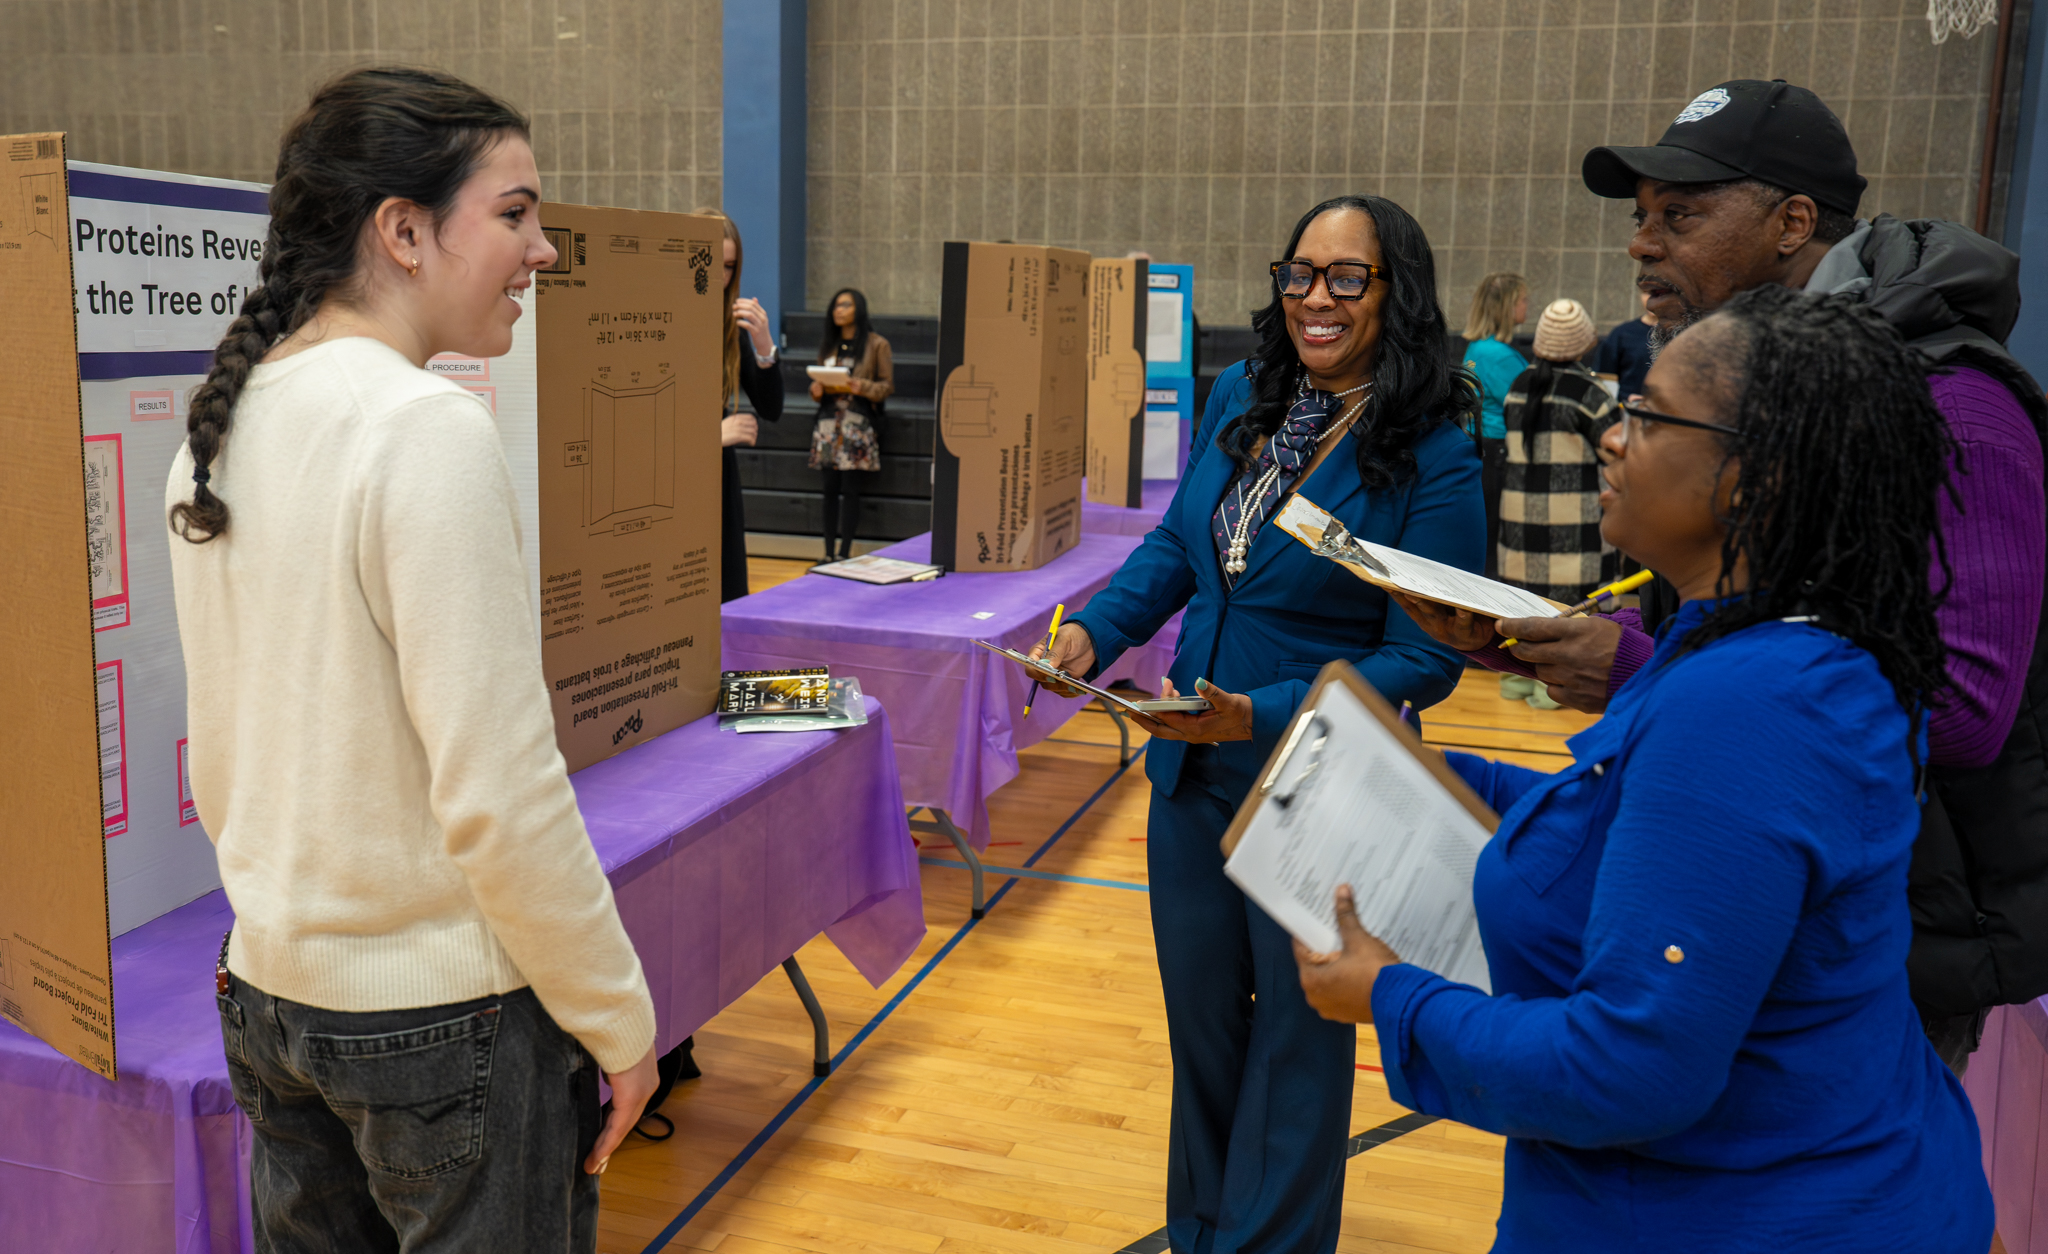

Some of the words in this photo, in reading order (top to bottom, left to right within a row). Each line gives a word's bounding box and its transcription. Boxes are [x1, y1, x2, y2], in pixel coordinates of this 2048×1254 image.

[75, 218, 194, 259] Proteins
[202, 229, 266, 262] Reve
[86, 280, 134, 315] the
[141, 284, 202, 315] Tree
[210, 284, 237, 315] of
[138, 401, 167, 411] RESULTS
[1022, 413, 1032, 449] battants
[999, 448, 1009, 475] Board
[1010, 444, 1020, 509] presentaciones
[997, 476, 1007, 531] Presentation
[1010, 511, 1018, 531] para
[663, 635, 693, 654] Panneau
[614, 661, 619, 673] à
[621, 646, 662, 669] d'affichage
[555, 670, 590, 691] battants
[593, 663, 612, 679] trois
[635, 665, 652, 681] para
[572, 671, 633, 705] presentaciones
[651, 676, 678, 698] Tri-Fold
[728, 682, 740, 712] MARY
[744, 682, 757, 712] HAIL
[800, 679, 810, 709] WEIR
[816, 678, 829, 708] ANDY
[600, 687, 650, 713] Presentation
[573, 706, 599, 728] Board
[612, 709, 644, 747] Pacon
[30, 959, 44, 974] triples
[45, 967, 53, 978] plis
[33, 976, 54, 997] Board
[76, 984, 83, 995] de
[84, 987, 107, 1006] panneau
[54, 988, 79, 1011] Project
[80, 1002, 97, 1021] Fold
[98, 1011, 108, 1027] Tri
[71, 1014, 109, 1043] White/Blanc
